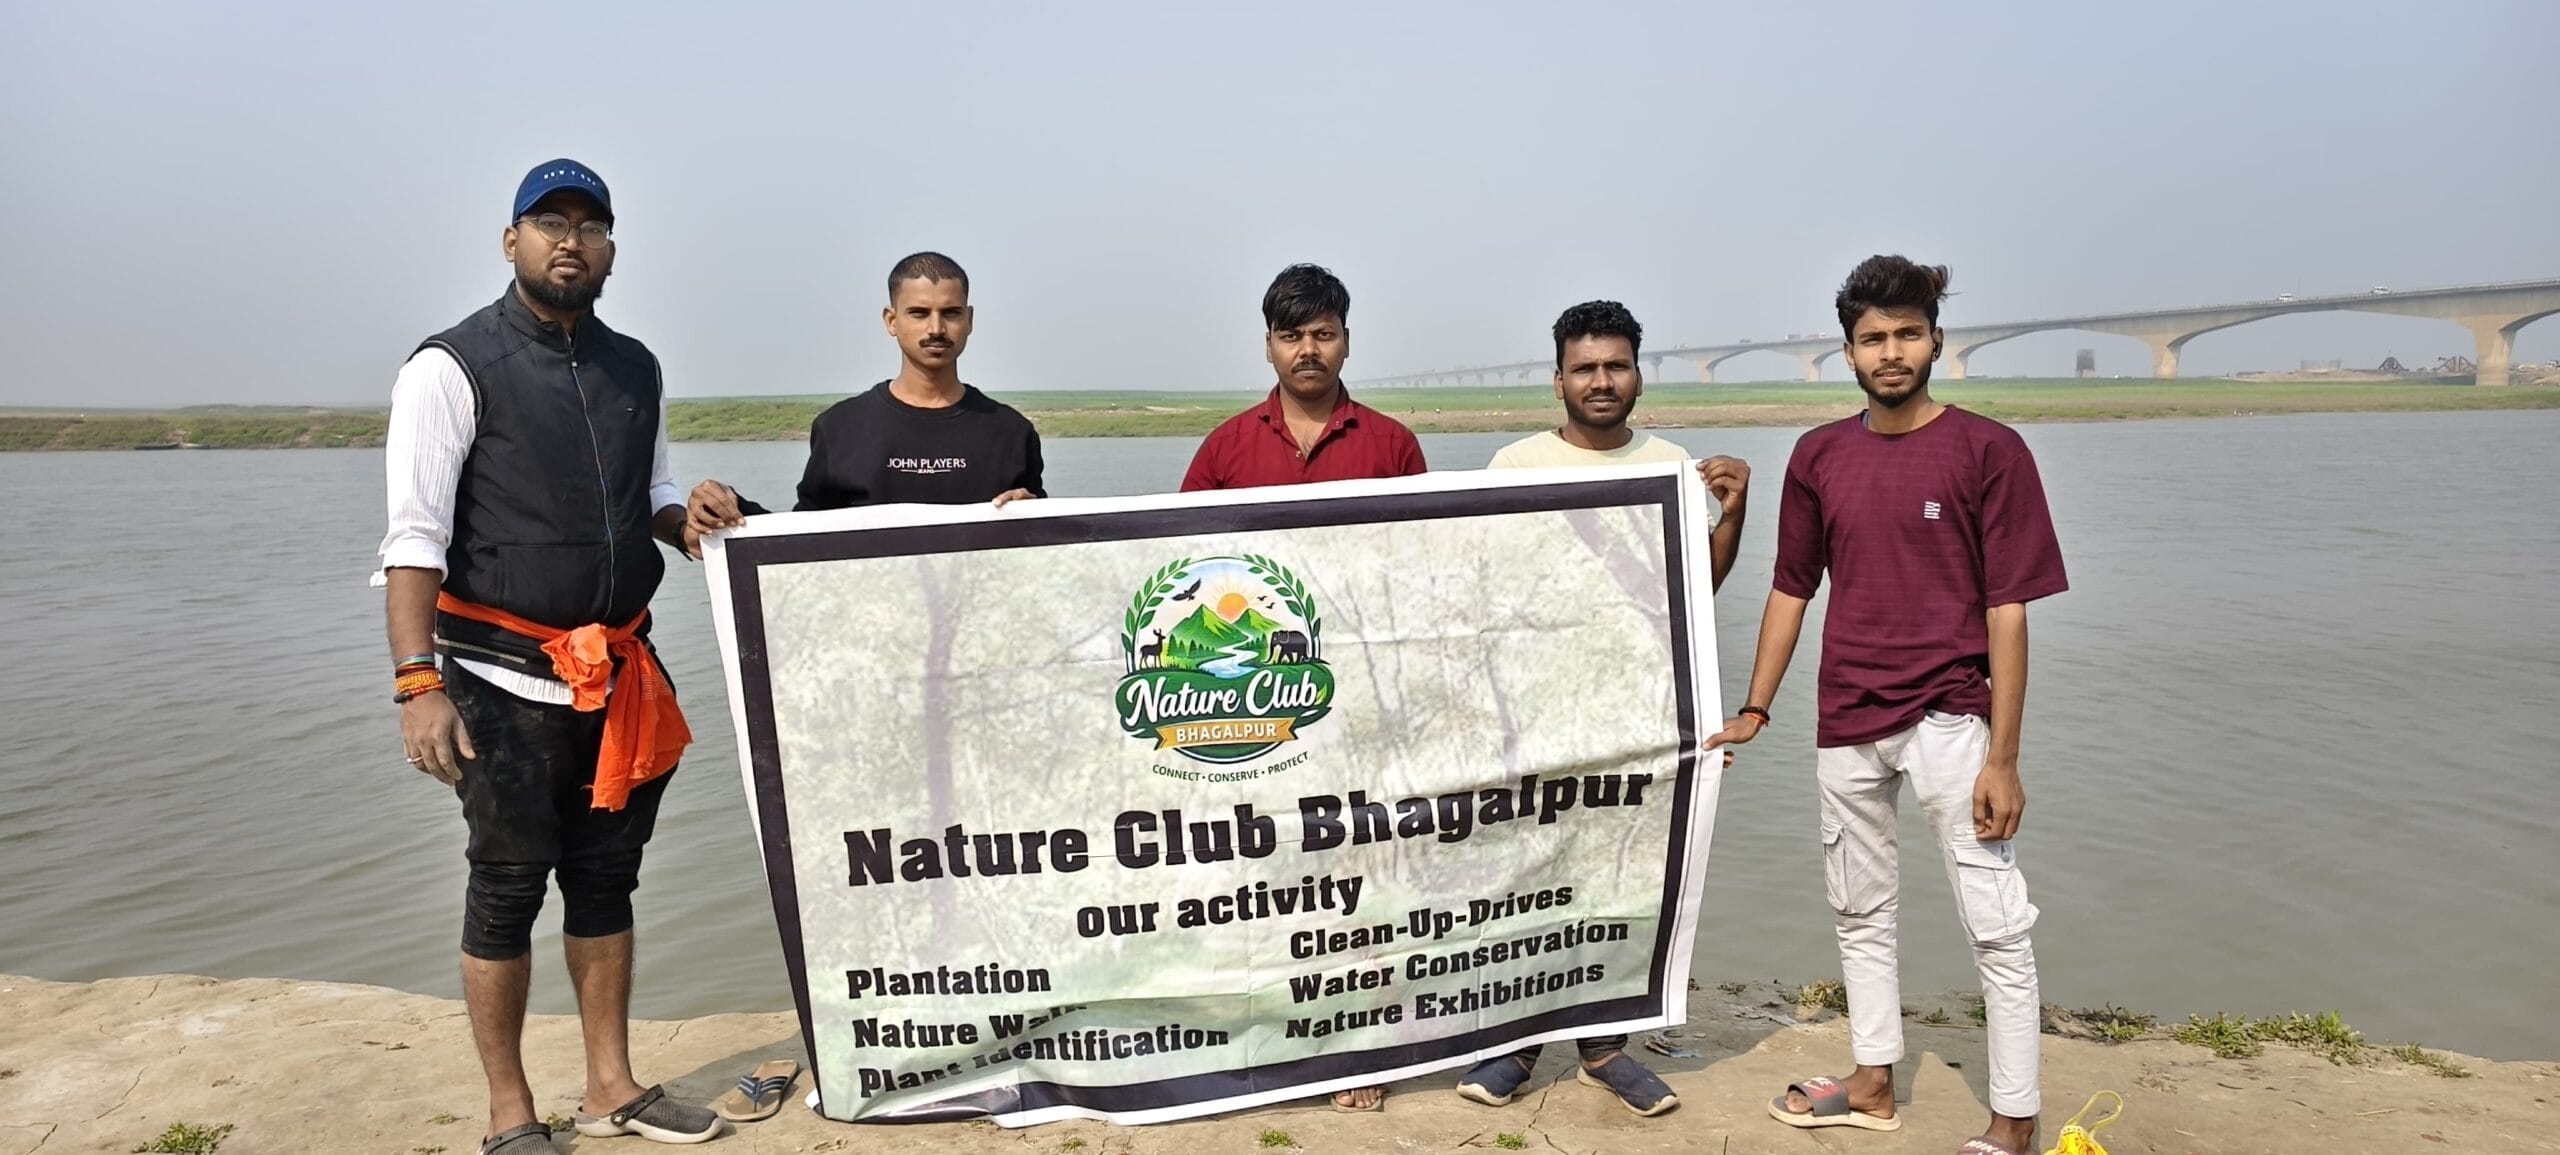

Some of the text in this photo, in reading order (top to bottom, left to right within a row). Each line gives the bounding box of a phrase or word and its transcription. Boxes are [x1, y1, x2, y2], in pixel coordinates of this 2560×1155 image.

[886, 457, 967, 469] JOHN PLAYERS
[1125, 670, 1318, 727] Nature Club
[1175, 722, 1277, 743] BHAGALPUR
[1152, 751, 1309, 783] CONNECT CONSERVE PROTECT
[843, 773, 1653, 886] Nature Club Bhagalpur
[1076, 874, 1363, 938] our activity
[1290, 886, 1574, 959] Clean-Up-Drives
[846, 963, 1051, 999] Plantation
[1289, 919, 1629, 1004] Water Conservation
[1285, 962, 1605, 1039] Nature Exhibitions
[852, 1016, 979, 1049] Nature
[858, 1023, 1229, 1098] Plant Identification
